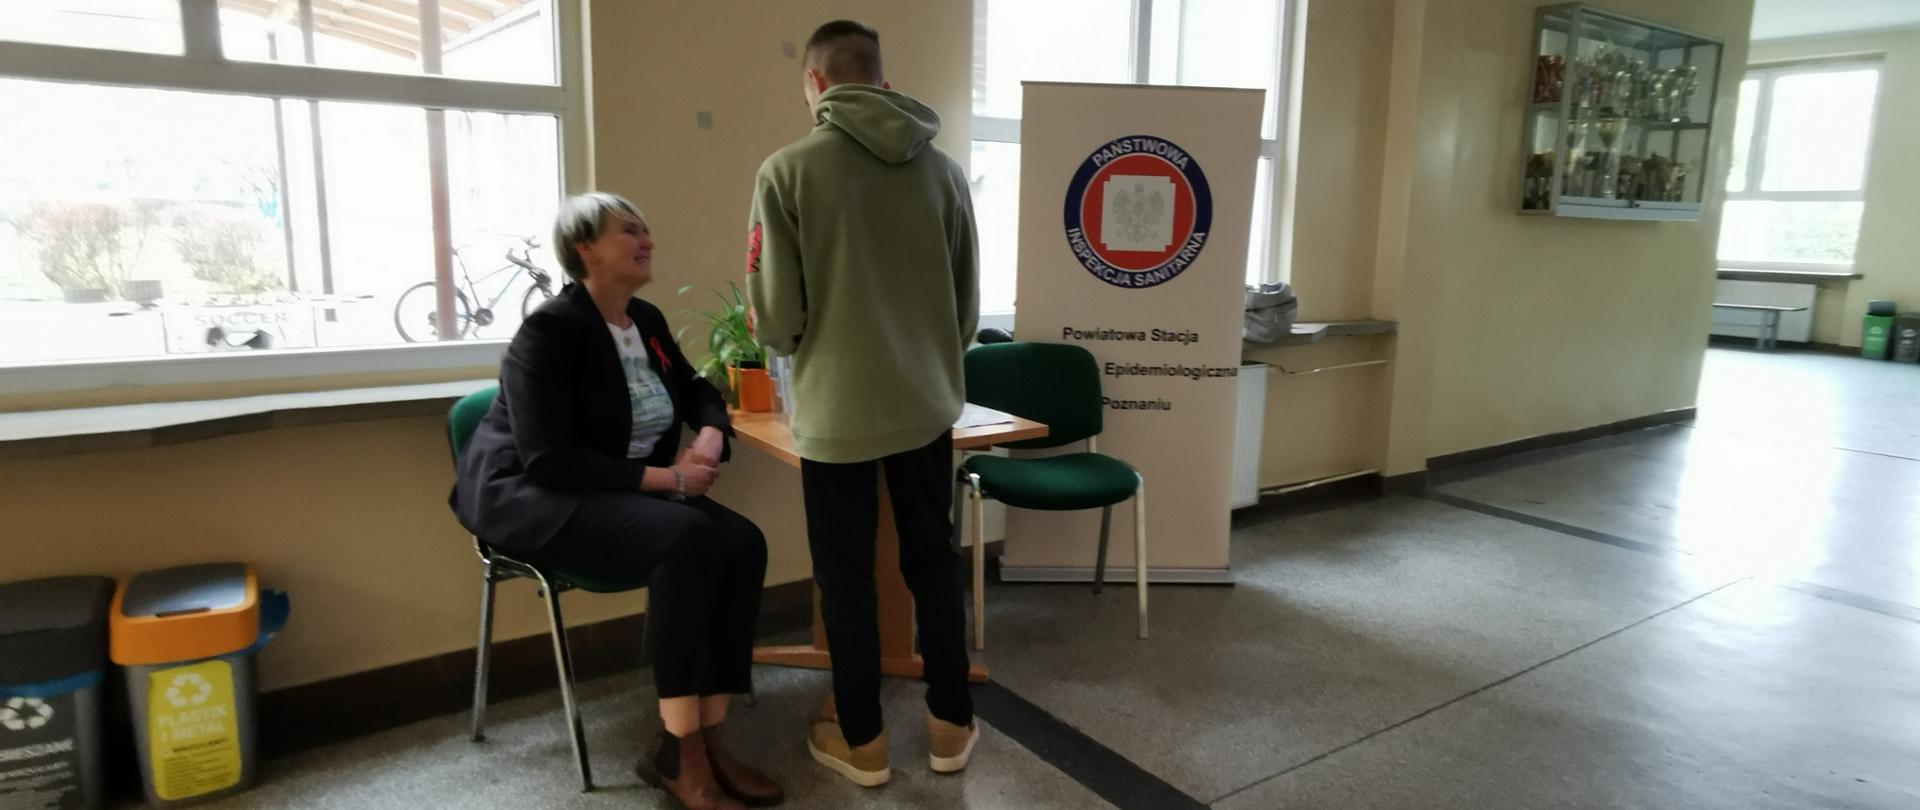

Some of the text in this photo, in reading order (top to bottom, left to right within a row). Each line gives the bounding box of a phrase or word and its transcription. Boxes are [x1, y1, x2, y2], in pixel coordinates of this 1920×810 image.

[1092, 137, 1189, 170] PAŃSTWOWA
[1068, 227, 1206, 287] INSPEKCJA SANITARNA
[195, 311, 287, 327] SOCCER
[1062, 326, 1199, 346] Powiatowa Stacja
[1104, 362, 1238, 381] Epidemiologiczna
[1101, 396, 1171, 411] Poznaniu
[158, 704, 228, 727] PLASTIK
[172, 720, 229, 741] METAL
